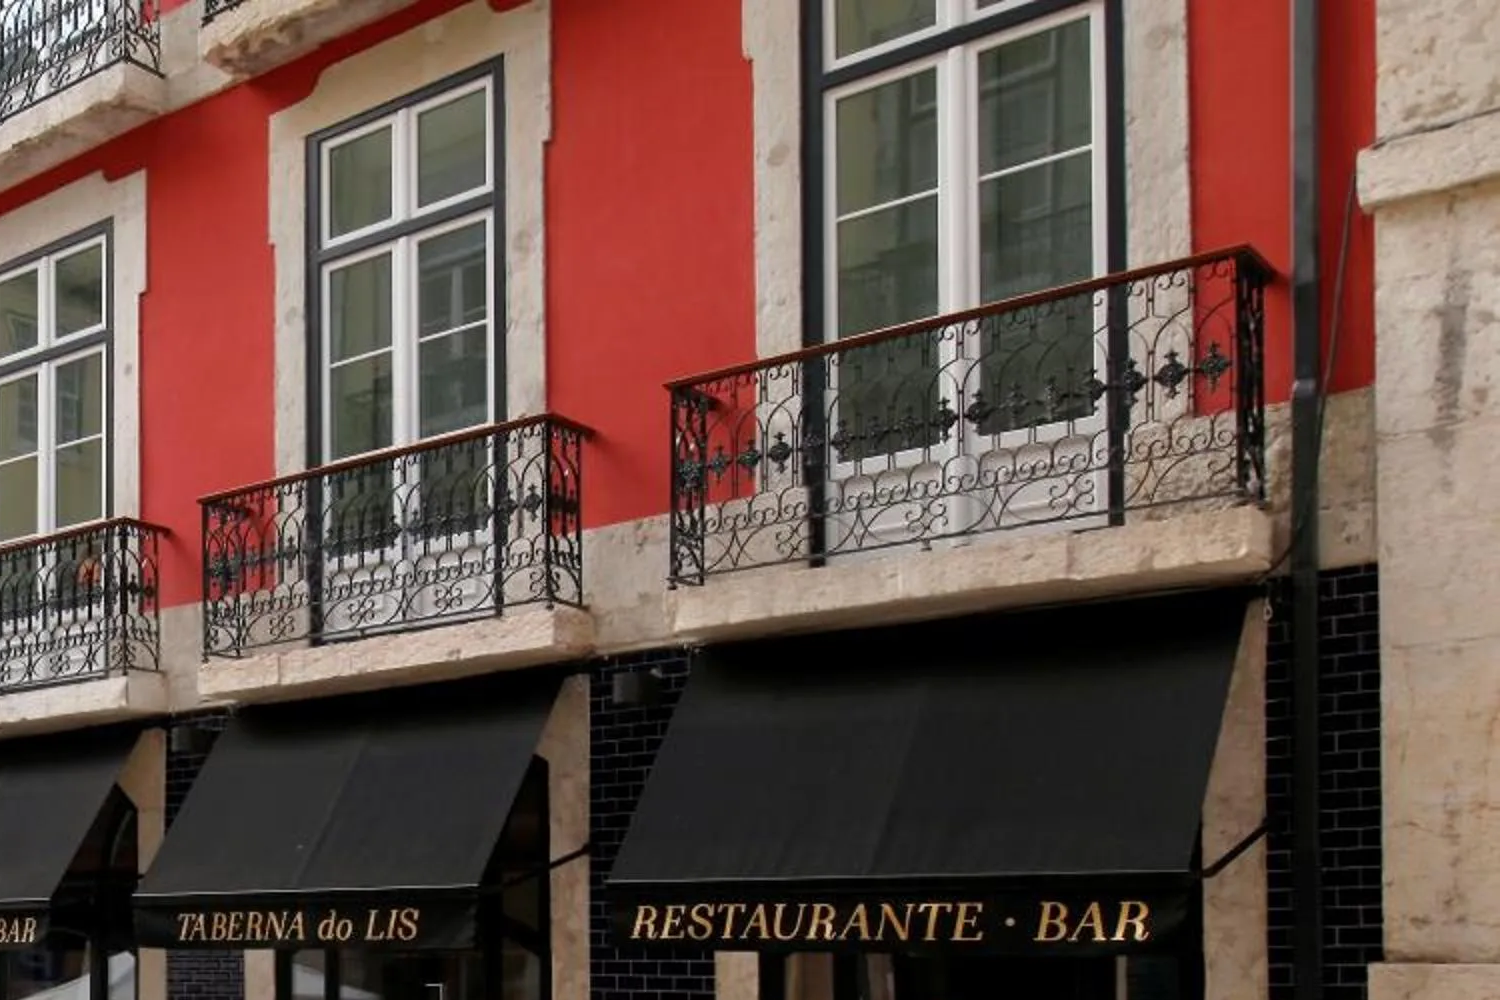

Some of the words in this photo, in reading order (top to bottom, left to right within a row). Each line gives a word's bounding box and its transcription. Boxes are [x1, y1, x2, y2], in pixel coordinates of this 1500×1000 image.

[177, 910, 305, 941] TABERNA
[317, 909, 352, 941] do
[364, 907, 420, 941] LIS
[629, 902, 984, 941] RESTAURANTE
[1033, 900, 1150, 941] BAR
